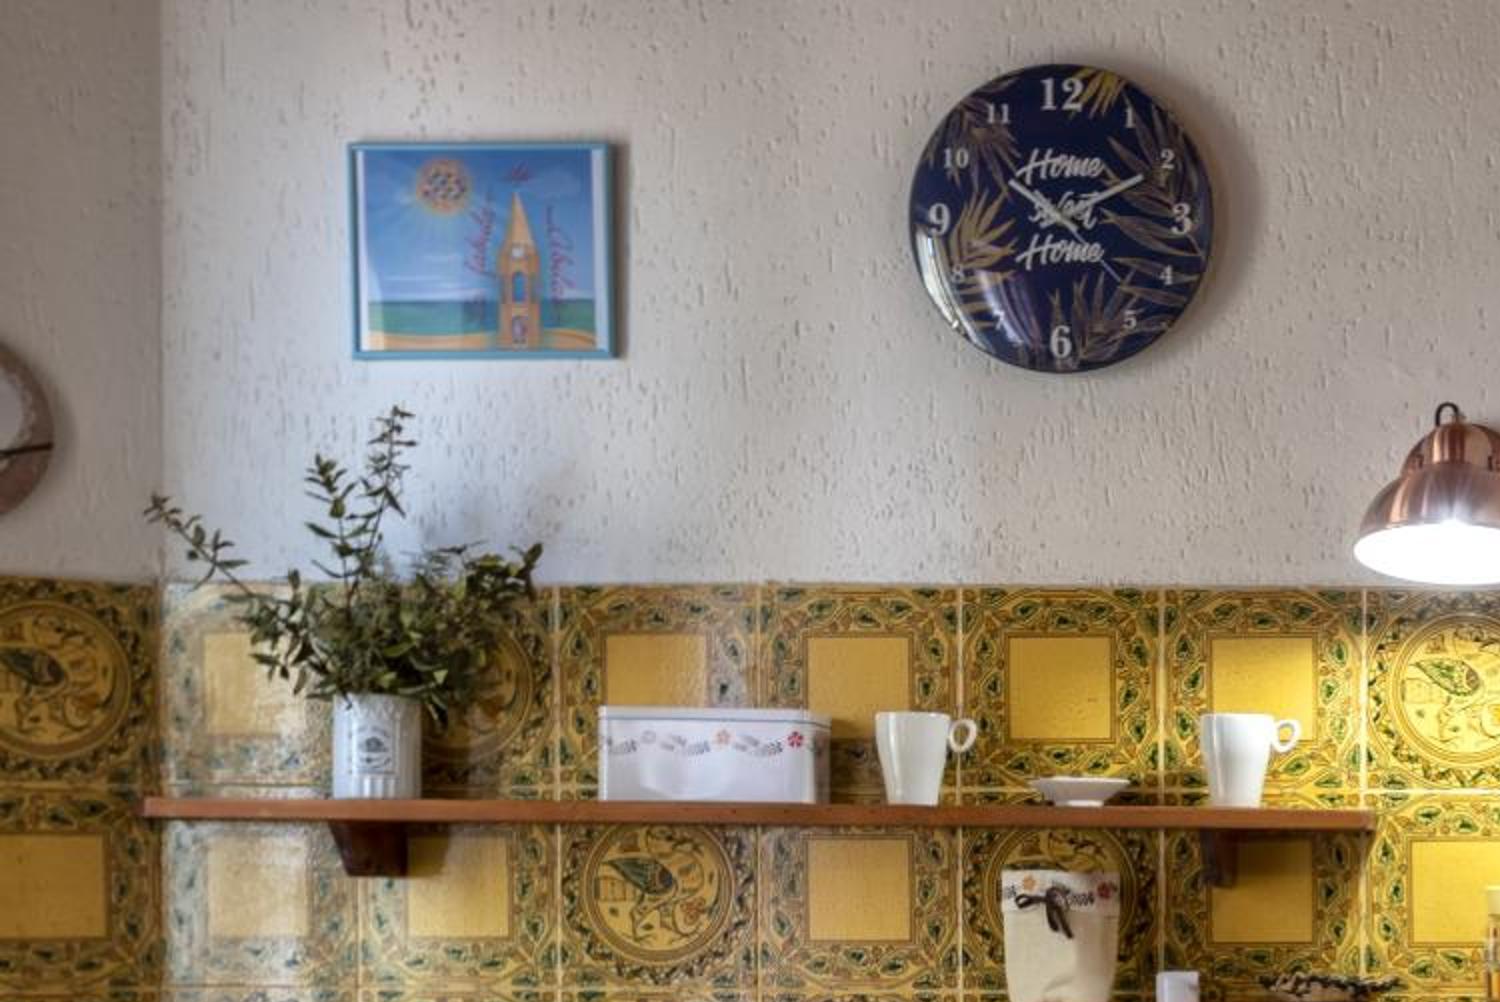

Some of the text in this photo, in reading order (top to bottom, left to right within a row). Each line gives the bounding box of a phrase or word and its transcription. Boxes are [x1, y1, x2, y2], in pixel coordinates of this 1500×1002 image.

[1040, 77, 1083, 111] 12
[987, 104, 1011, 124] 11
[1125, 107, 1136, 128] 1
[943, 148, 969, 168] 10
[1015, 148, 1104, 185] Home
[1161, 150, 1174, 169] 2
[928, 203, 949, 234] 9
[1171, 203, 1192, 234] 3
[1015, 233, 1104, 271] Home
[951, 263, 965, 282] 8
[1159, 266, 1174, 285] 4
[993, 310, 1005, 329] 7
[1123, 310, 1137, 331] 5
[1050, 326, 1072, 359] 6
